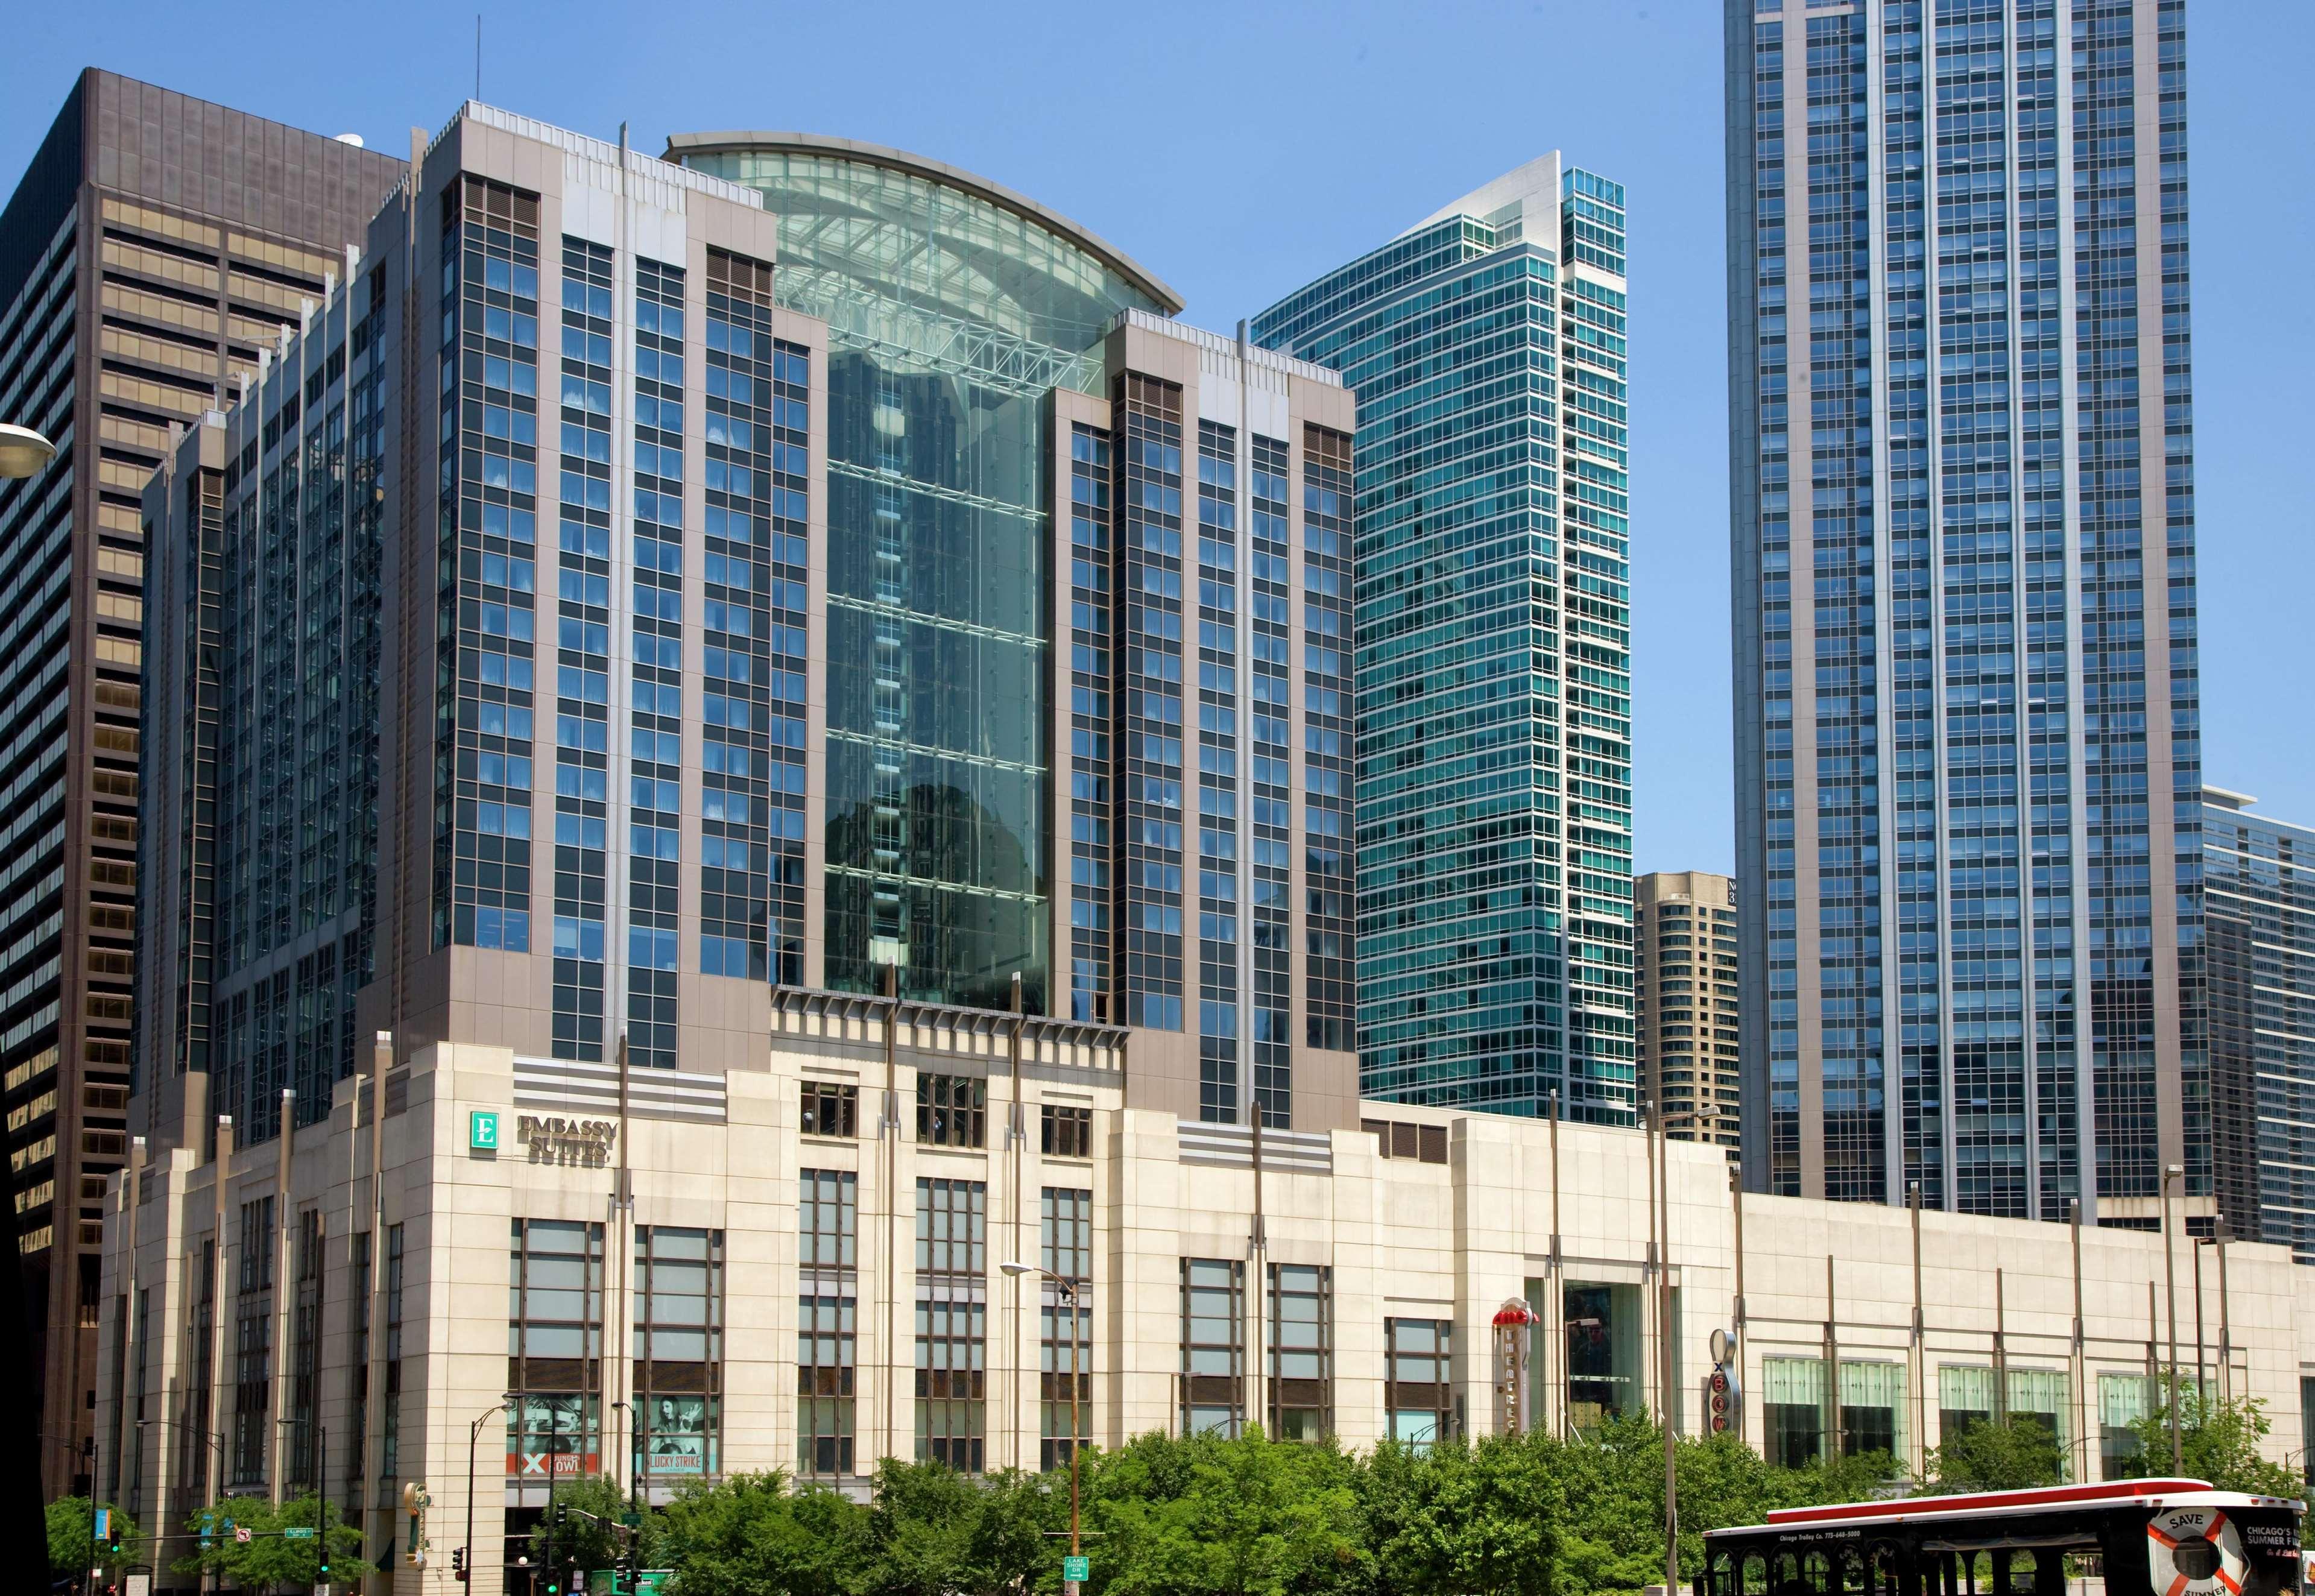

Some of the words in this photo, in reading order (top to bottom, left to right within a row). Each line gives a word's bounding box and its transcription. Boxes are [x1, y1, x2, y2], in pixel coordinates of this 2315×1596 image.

[476, 1117, 494, 1143] E
[517, 1115, 618, 1138] EMBASSY
[530, 1137, 607, 1156] SUITES
[1714, 1363, 1723, 1372] X
[523, 1453, 546, 1474] X
[649, 1456, 674, 1468] LUCKY
[675, 1456, 701, 1468] STRIKE
[2169, 1514, 2203, 1529] SAVE
[2247, 1526, 2290, 1536] CHICAGO'S
[2247, 1535, 2285, 1545] SUMMER
